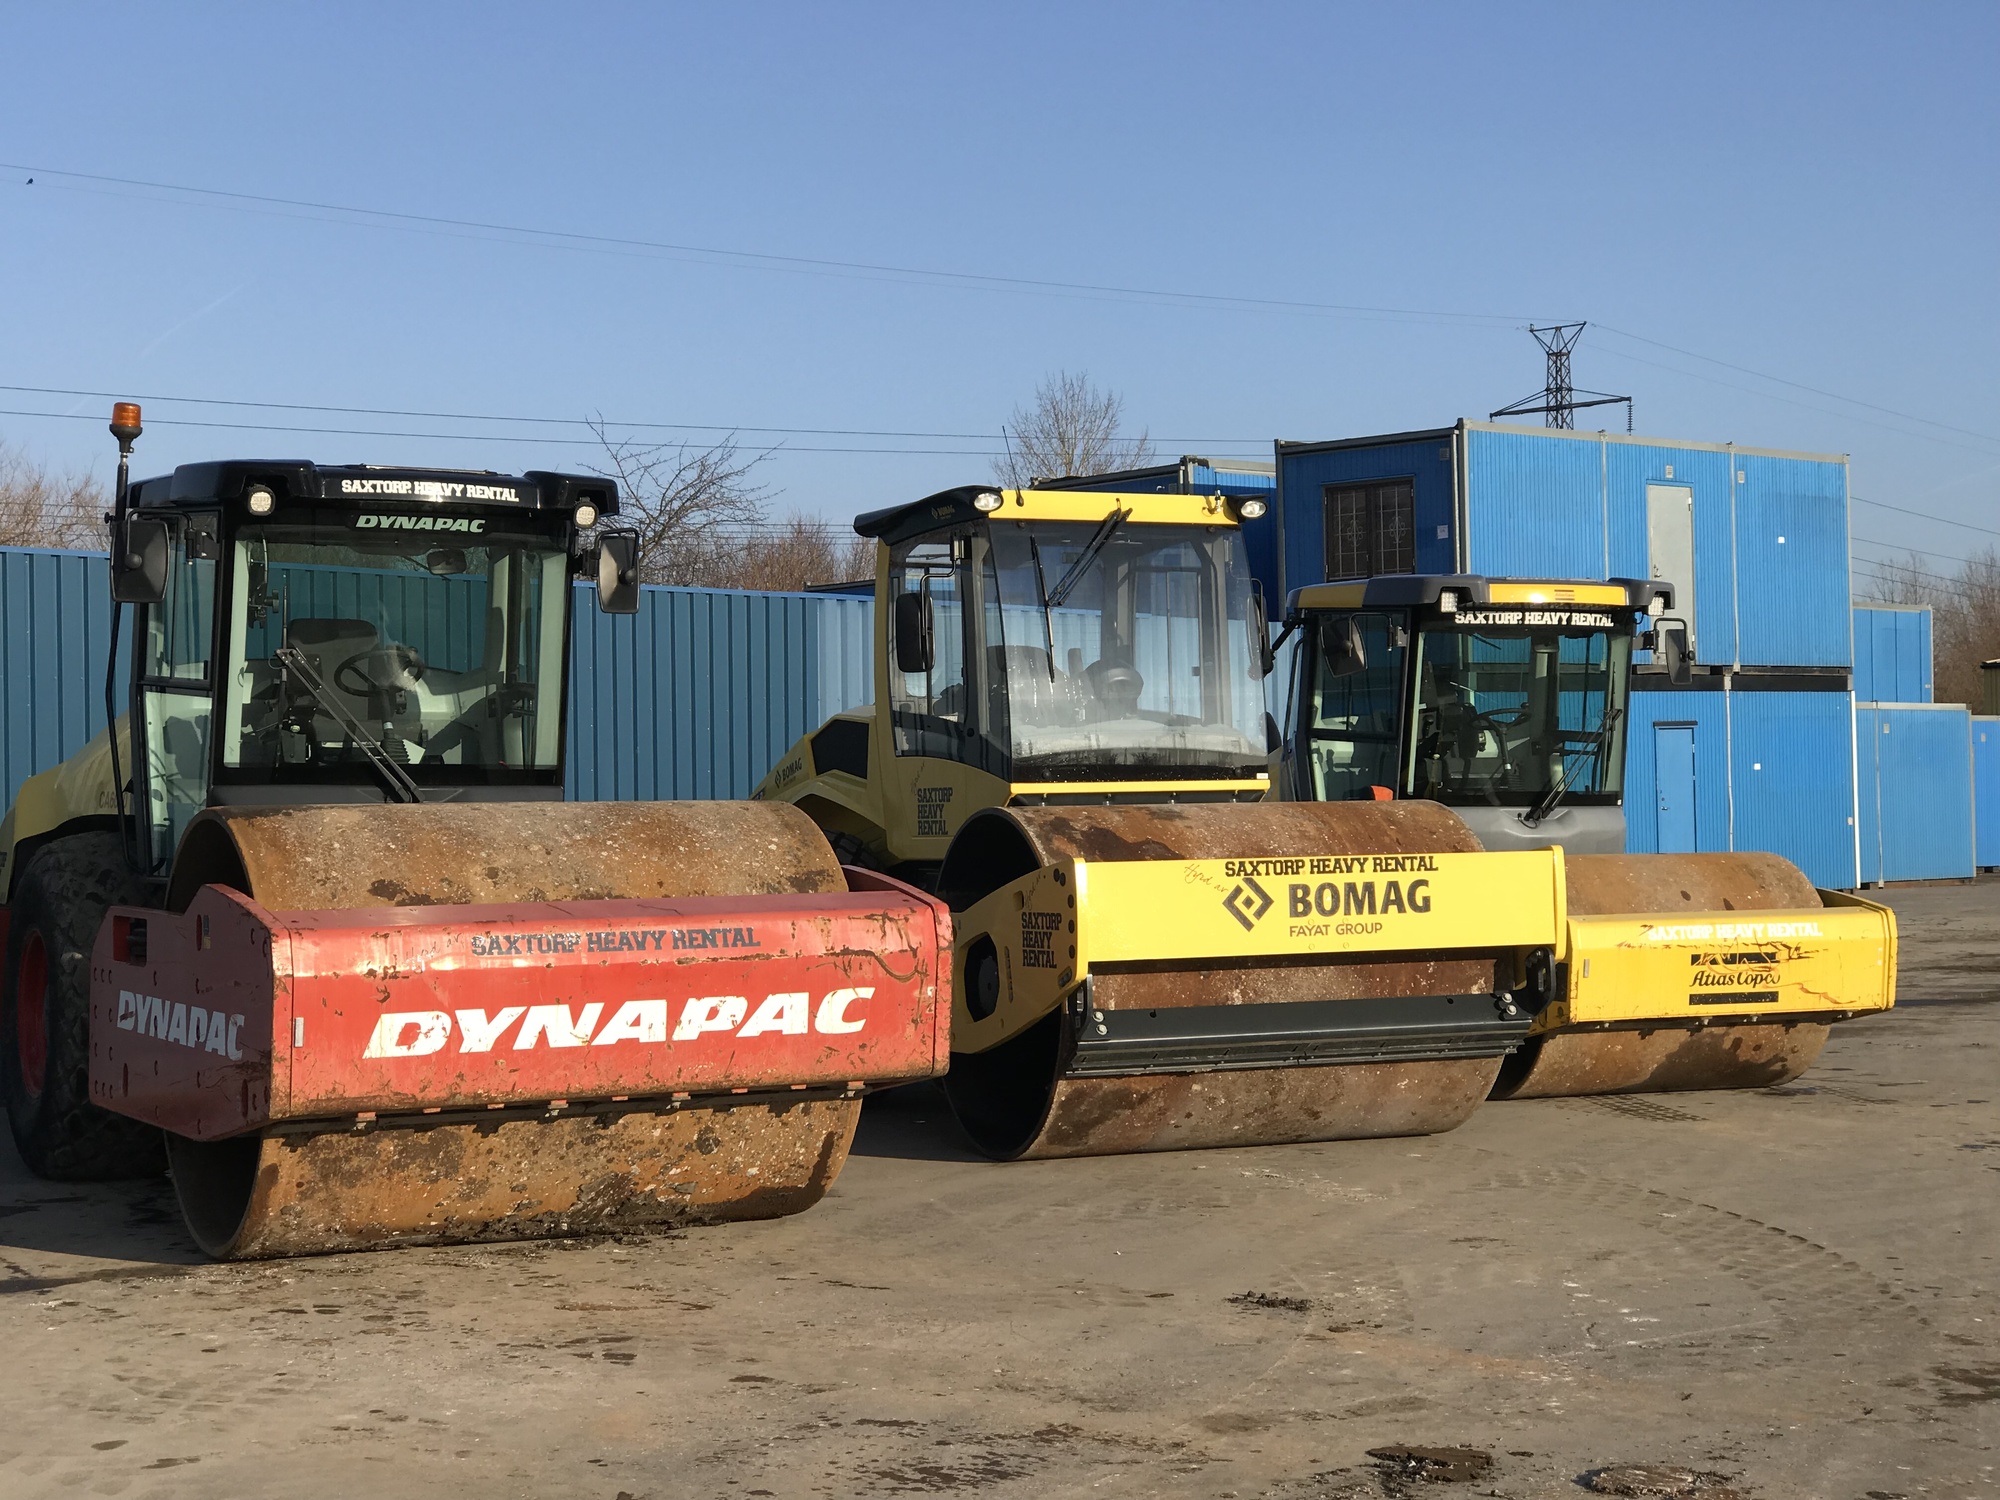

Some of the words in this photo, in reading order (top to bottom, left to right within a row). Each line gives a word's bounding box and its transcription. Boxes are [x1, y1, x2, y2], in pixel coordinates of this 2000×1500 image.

[414, 481, 464, 498] HEAVY
[466, 484, 519, 502] RENTAL
[356, 515, 486, 533] DYNAPAC
[1524, 612, 1571, 626] HEAVY
[1571, 612, 1614, 627] RENTAL
[782, 757, 803, 782] BOMAG
[917, 787, 954, 803] SAXTORP
[917, 803, 945, 819] HEAVY
[917, 820, 948, 836] RENTAL
[1309, 857, 1370, 875] HEAVY
[1372, 855, 1439, 873] RENTAL
[1288, 878, 1432, 919] BOMAG
[1021, 911, 1062, 930] SAXTORP
[1289, 924, 1331, 937] FAYAT
[1335, 922, 1383, 936] GROUP
[1022, 930, 1052, 949] HEAVY
[1716, 923, 1764, 939] HEAVY
[1767, 922, 1823, 938] RENTAL
[471, 931, 581, 956] SAXTORP
[587, 928, 666, 953] HEAVY
[672, 927, 761, 950] RENTAL
[1022, 949, 1057, 969] RENTAL
[117, 989, 246, 1062] DYNAPAC
[362, 987, 876, 1059] DYNAPAC
